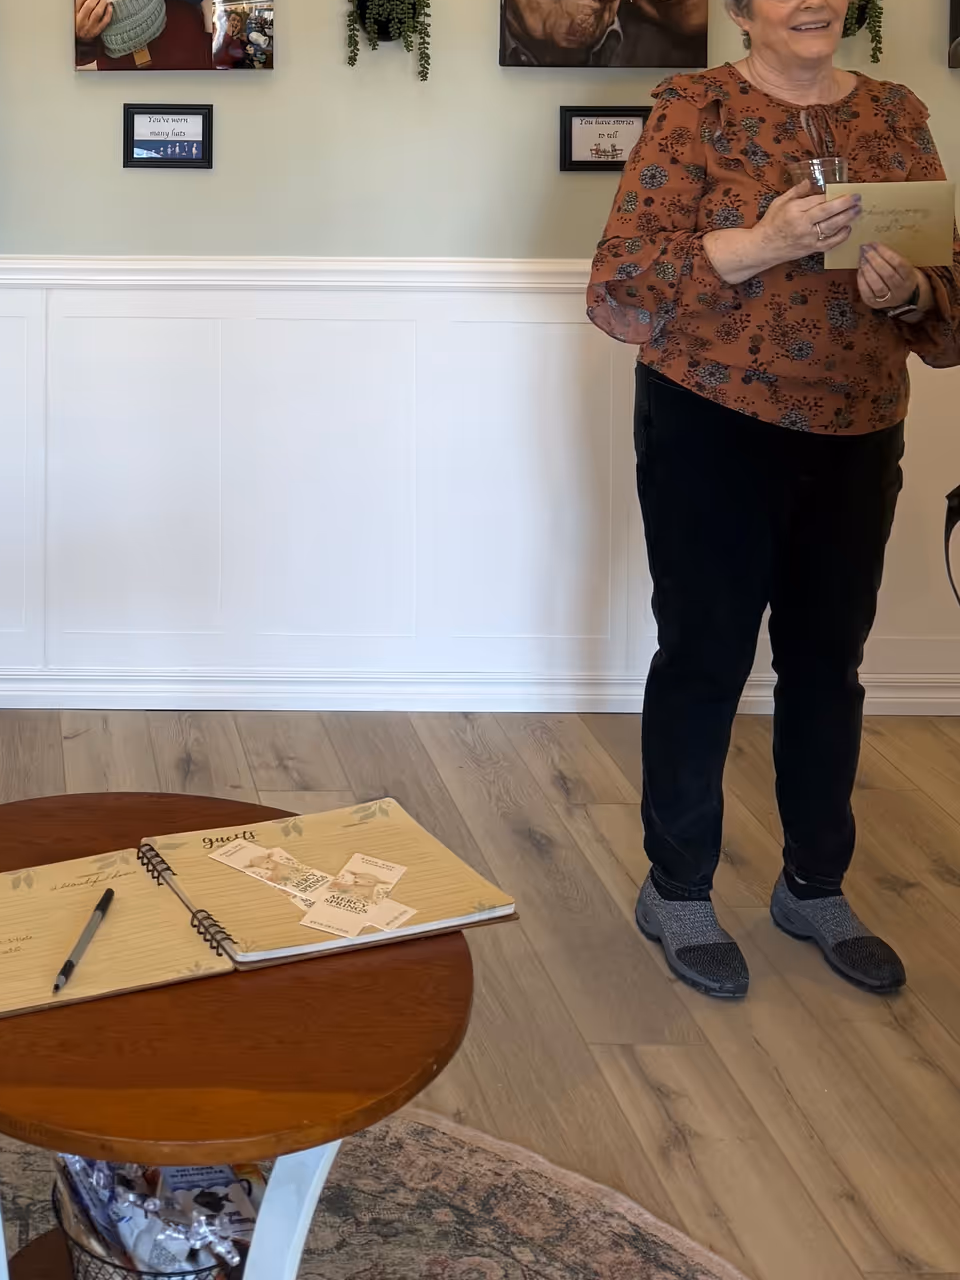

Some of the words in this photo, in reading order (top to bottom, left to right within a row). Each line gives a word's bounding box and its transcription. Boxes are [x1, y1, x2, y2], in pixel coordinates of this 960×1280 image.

[148, 115, 169, 124] You've
[579, 118, 593, 126] You
[594, 116, 611, 126] have
[612, 118, 634, 126] stories
[149, 131, 169, 139] many
[171, 128, 186, 137] hats
[607, 130, 619, 139] tell
[202, 829, 257, 850] guests
[292, 872, 318, 889] MERCY
[298, 874, 328, 893] SPRINGS
[323, 898, 369, 914] SPRINGS
[329, 894, 369, 908] MERCY
